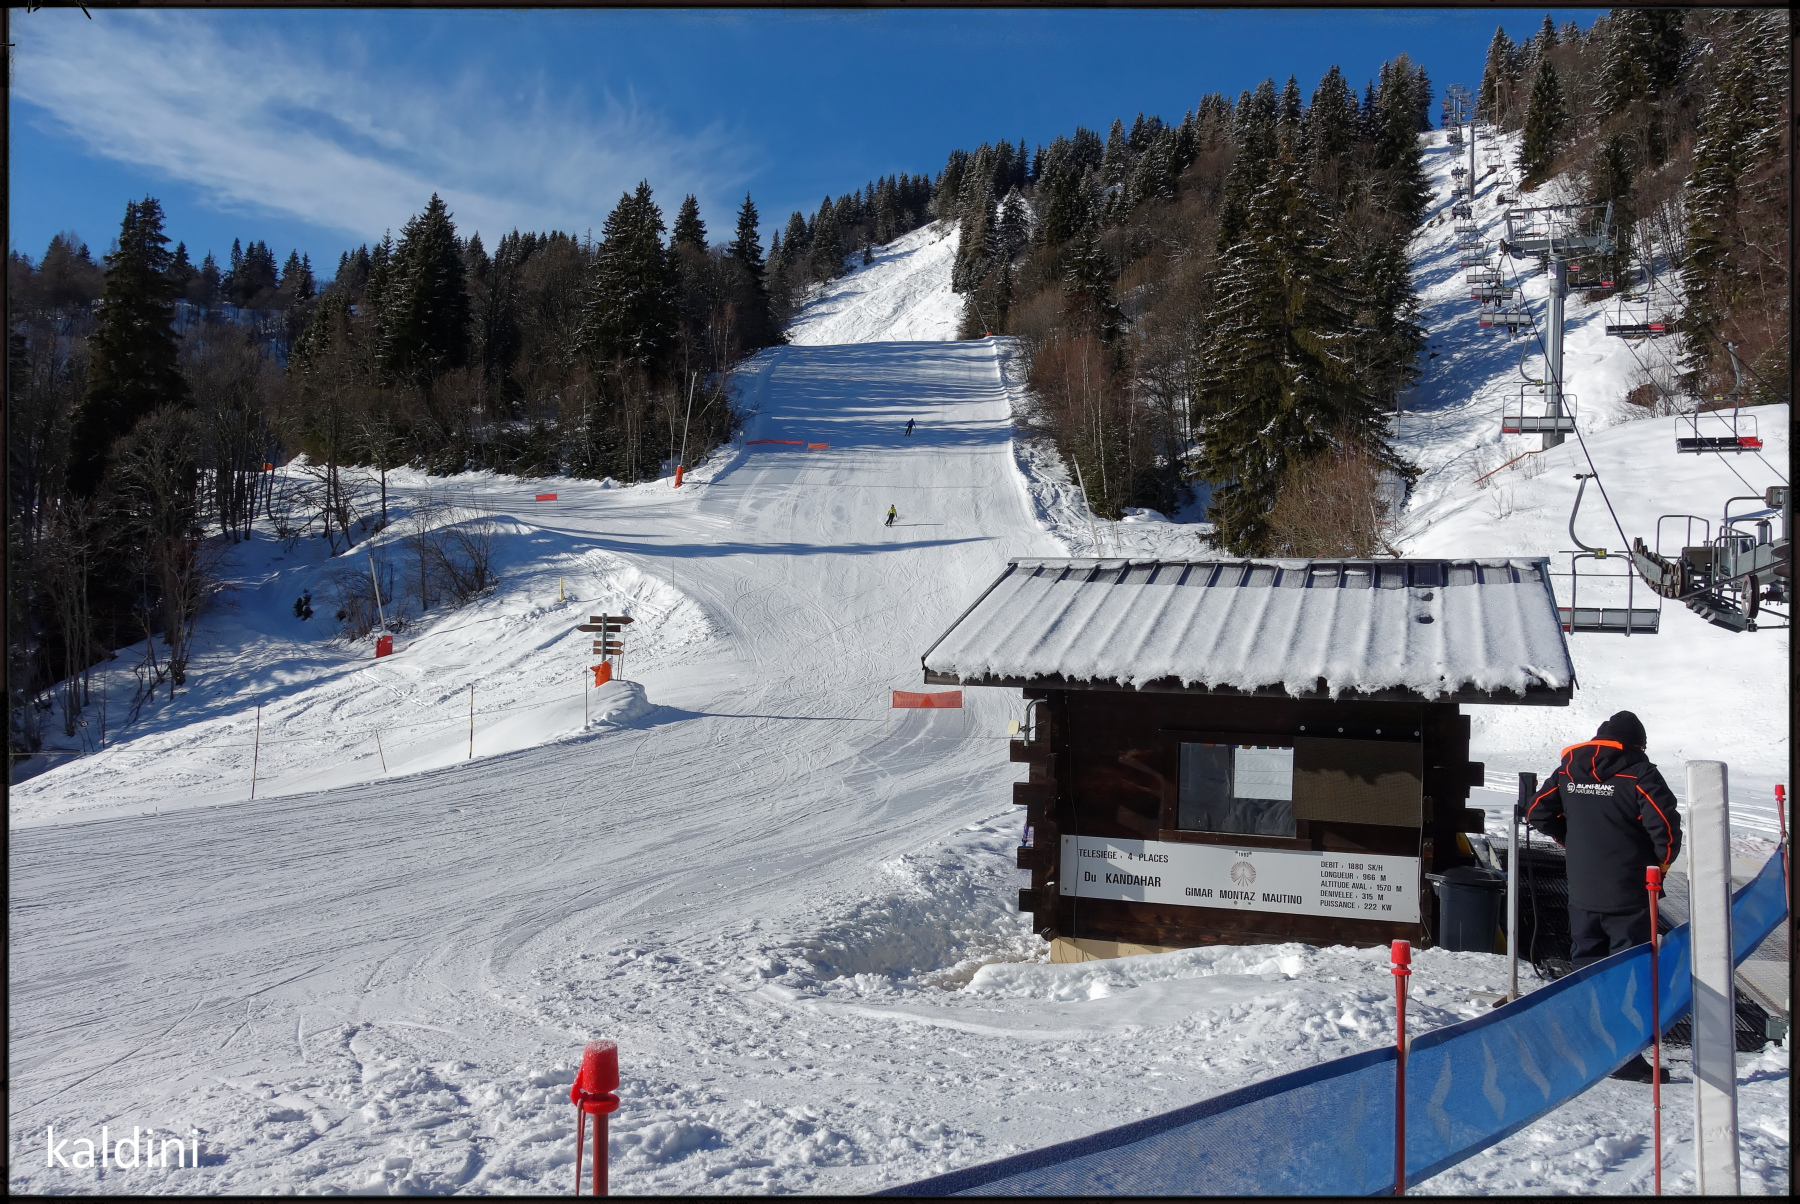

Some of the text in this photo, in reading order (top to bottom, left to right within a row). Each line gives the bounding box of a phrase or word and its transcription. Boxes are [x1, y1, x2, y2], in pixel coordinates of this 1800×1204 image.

[1079, 849, 1117, 859] TELESIEGE
[1139, 853, 1168, 863] PLACES
[1085, 871, 1161, 887] Du KANDAHAR
[1321, 871, 1353, 879] LONGUEUR
[1185, 887, 1302, 905] GIMAR MONTAZ MAUTINO
[1321, 890, 1353, 898] DENIVELEE
[1320, 900, 1355, 908] PUISSANCE
